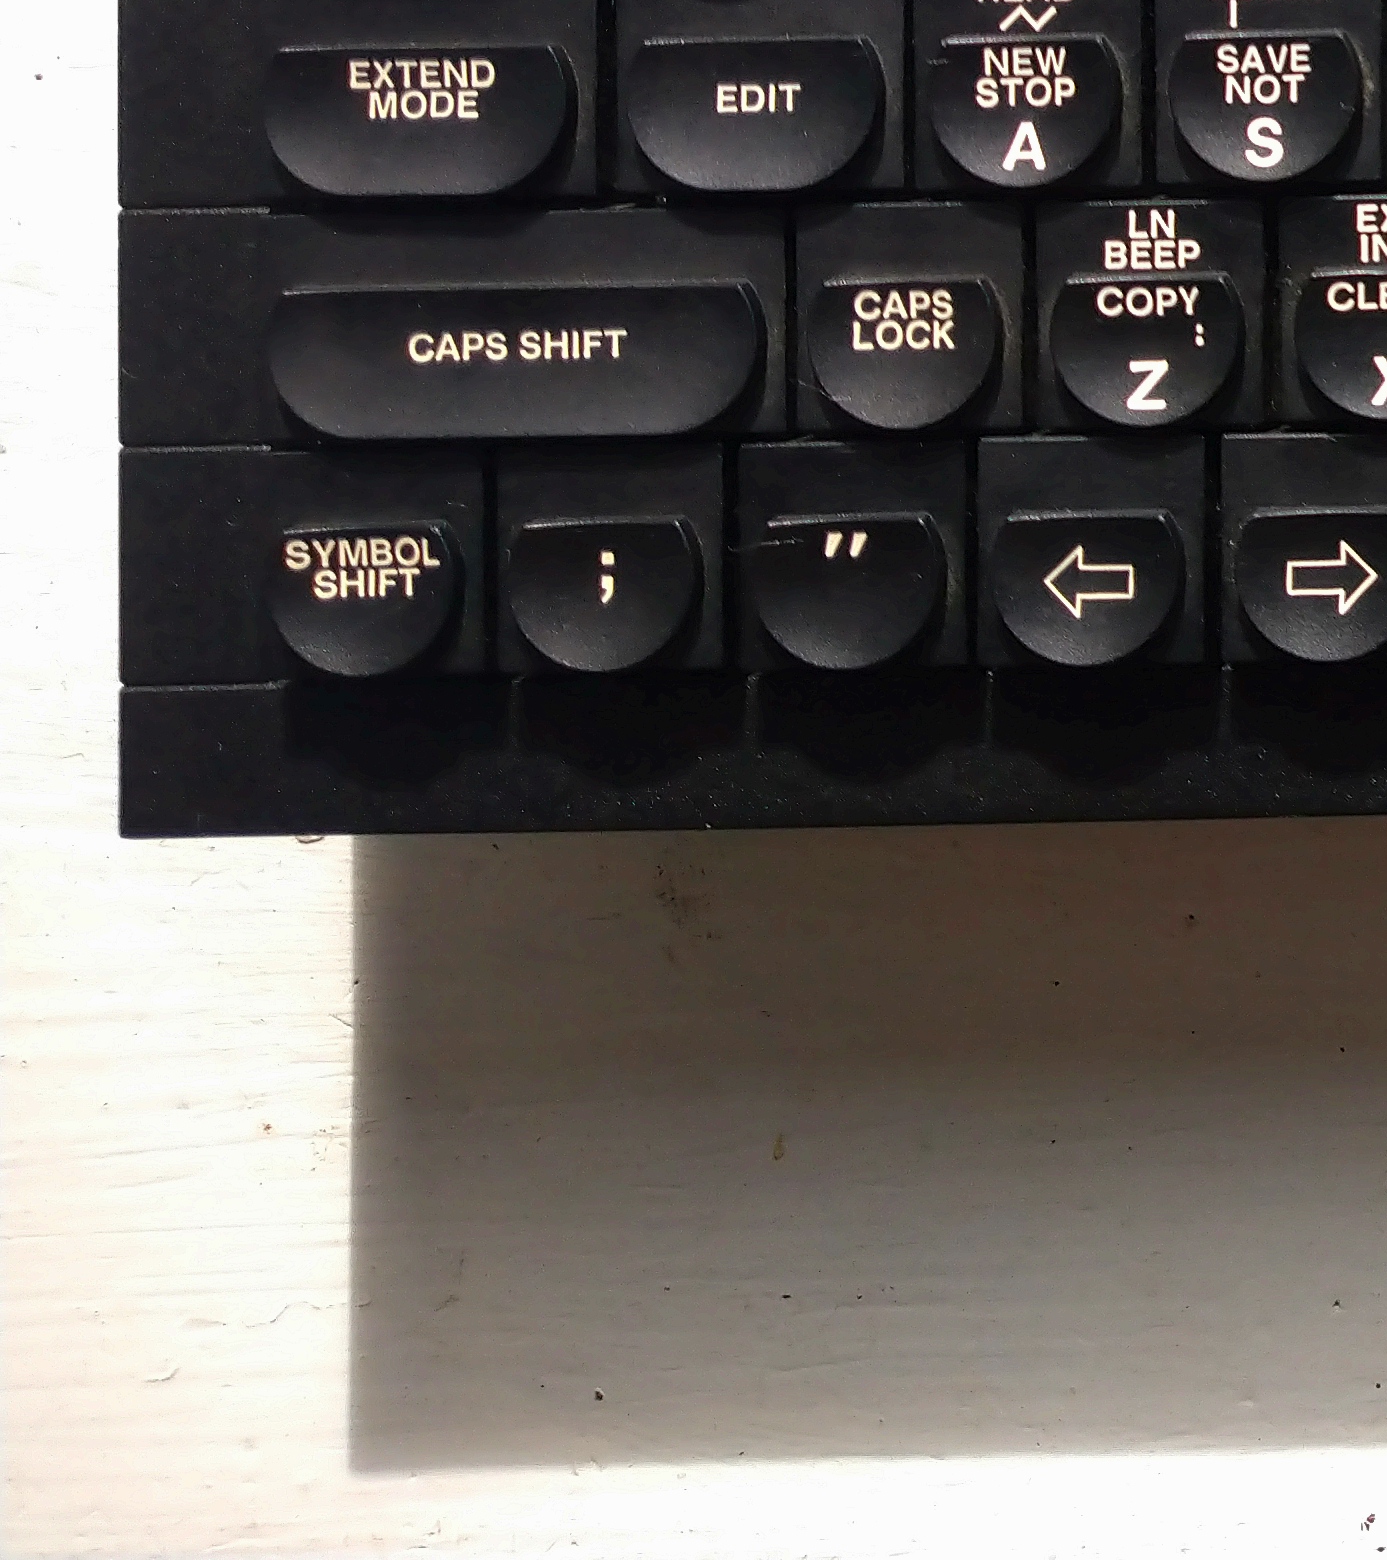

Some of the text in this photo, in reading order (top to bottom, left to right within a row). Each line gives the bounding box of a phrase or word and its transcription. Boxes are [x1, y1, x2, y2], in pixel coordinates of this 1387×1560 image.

[349, 59, 496, 90] EXTEND
[983, 46, 1067, 77] NEW
[1217, 43, 1312, 74] SAVE
[368, 90, 479, 120] MODE
[716, 83, 801, 114] EDIT
[975, 76, 1076, 109] STOP
[1225, 73, 1306, 105] NOT
[1001, 121, 1047, 172] A
[1244, 116, 1285, 168] S
[1128, 209, 1176, 240] LN
[1104, 239, 1201, 270] BEEP
[853, 289, 954, 321] CAPS
[1096, 286, 1199, 317] COPY
[408, 329, 628, 364] CAPS SHIFT
[852, 319, 955, 351] LOCK
[1126, 359, 1169, 411] Z
[285, 536, 441, 570] SYMBOL
[313, 567, 421, 600] SHIFT
